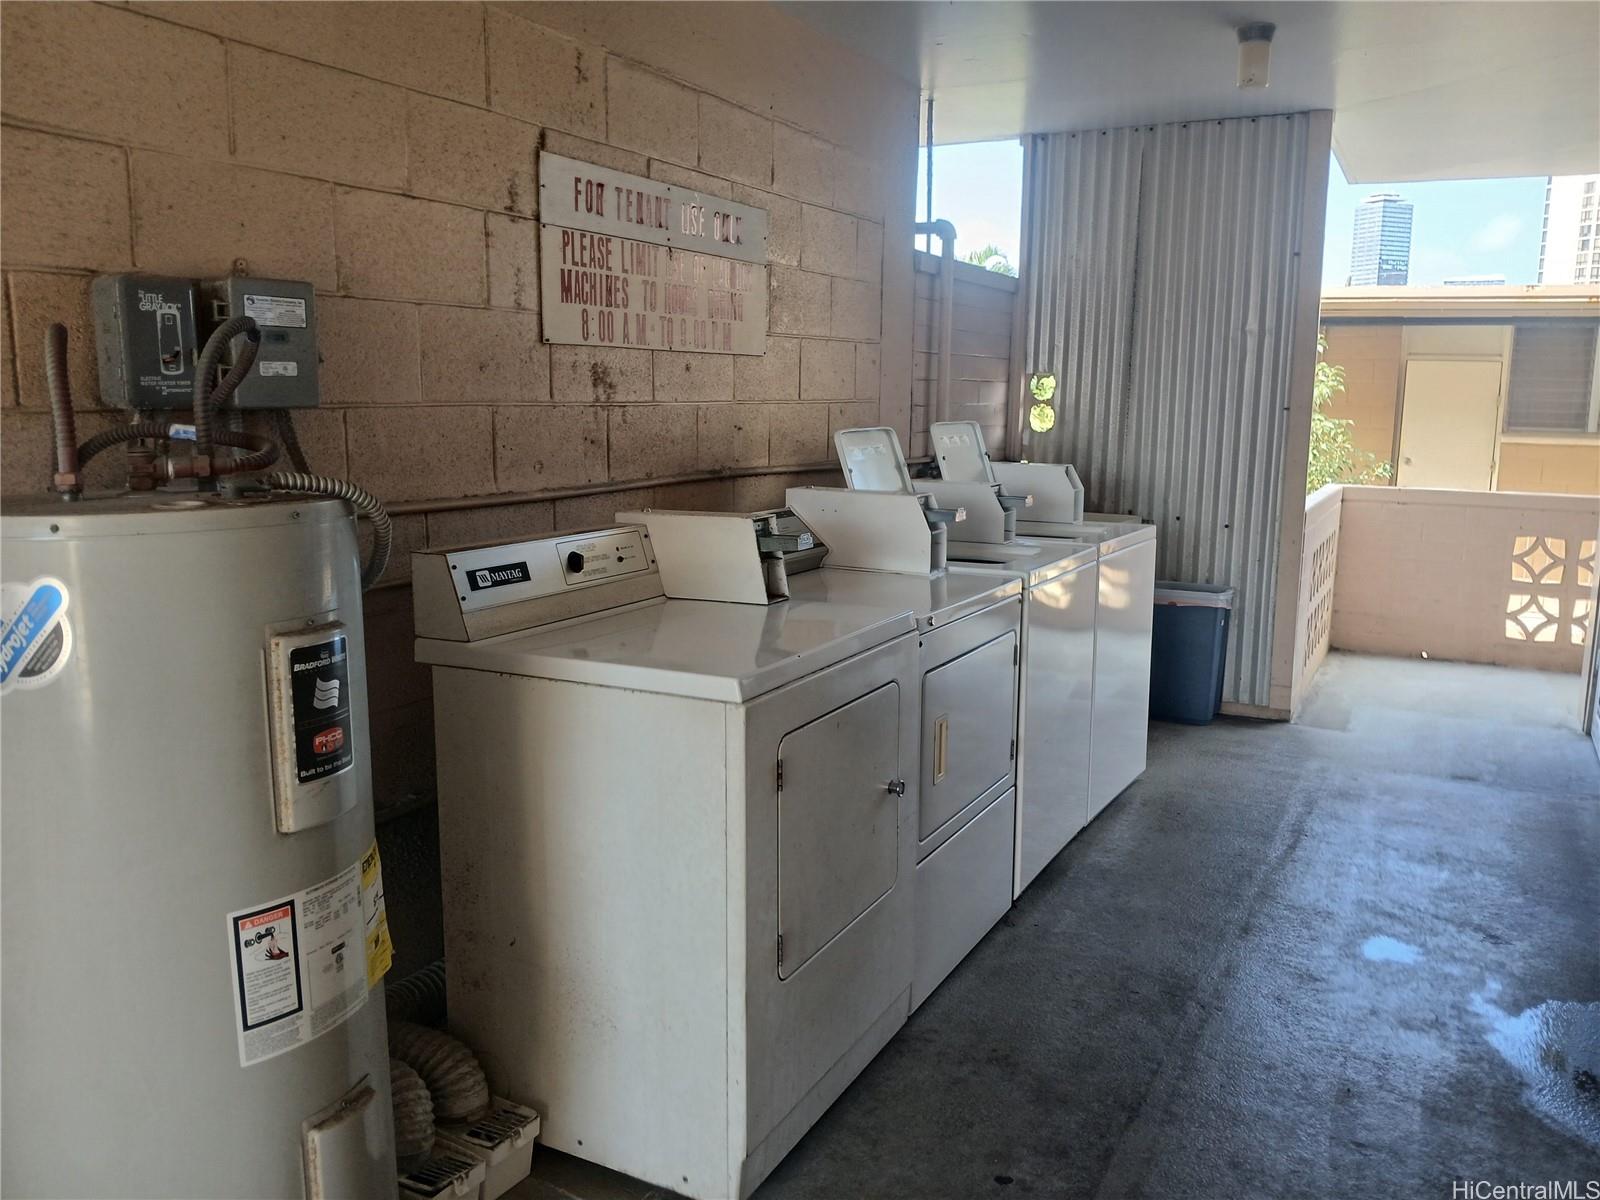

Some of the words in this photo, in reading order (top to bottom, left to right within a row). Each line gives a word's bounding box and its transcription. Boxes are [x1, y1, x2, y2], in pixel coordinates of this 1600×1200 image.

[574, 176, 605, 217] FOR
[615, 186, 671, 231] TENANT
[681, 203, 705, 237] USE
[562, 230, 612, 271] PLEASE
[621, 240, 660, 277] LIMIT
[560, 268, 630, 310] MACHINES
[642, 279, 657, 313] TO
[139, 302, 160, 312] GRAY
[581, 308, 614, 342] 8:00
[659, 315, 673, 347] TO
[491, 568, 523, 583] MAYTAG
[293, 658, 330, 672] BRADFORD
[254, 911, 284, 926] DANGER
